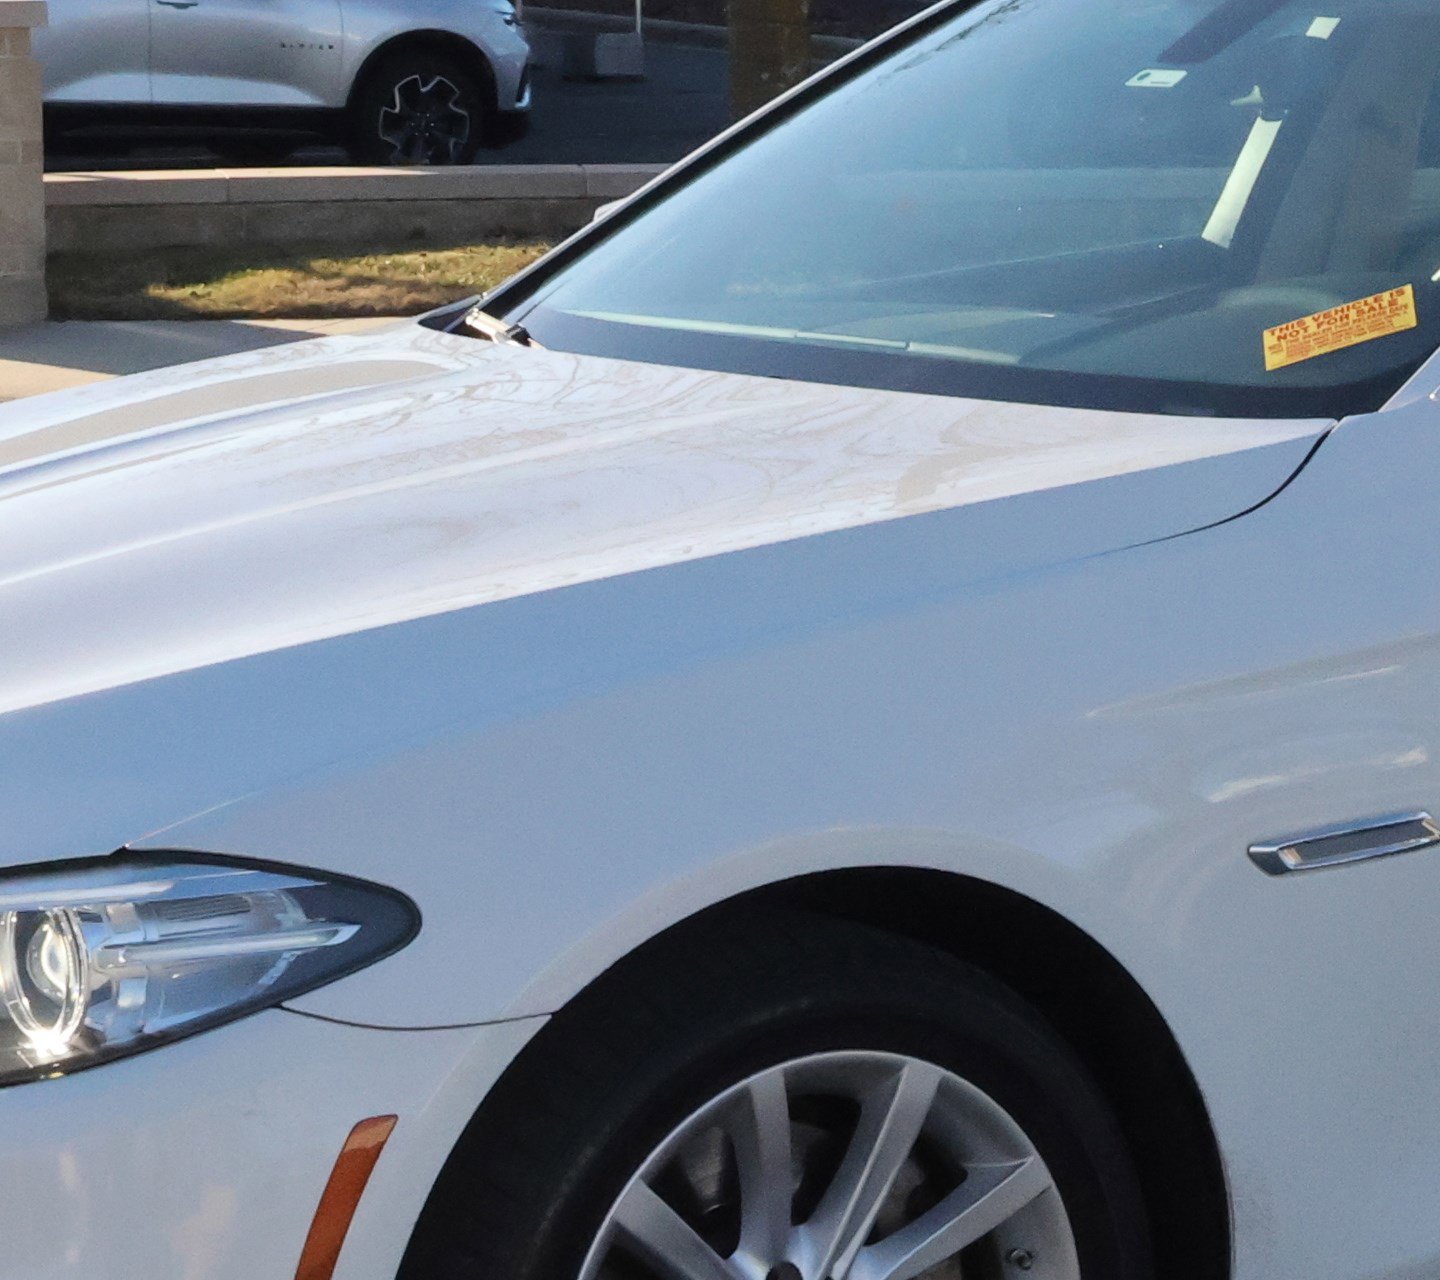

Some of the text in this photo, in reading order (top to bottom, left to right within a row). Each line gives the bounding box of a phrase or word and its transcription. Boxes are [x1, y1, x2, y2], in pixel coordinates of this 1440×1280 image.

[1269, 288, 1405, 336] THIS VEHICLE IS
[1276, 327, 1310, 342] NOT
[1316, 313, 1350, 329] FOR
[1356, 298, 1399, 318] SALE
